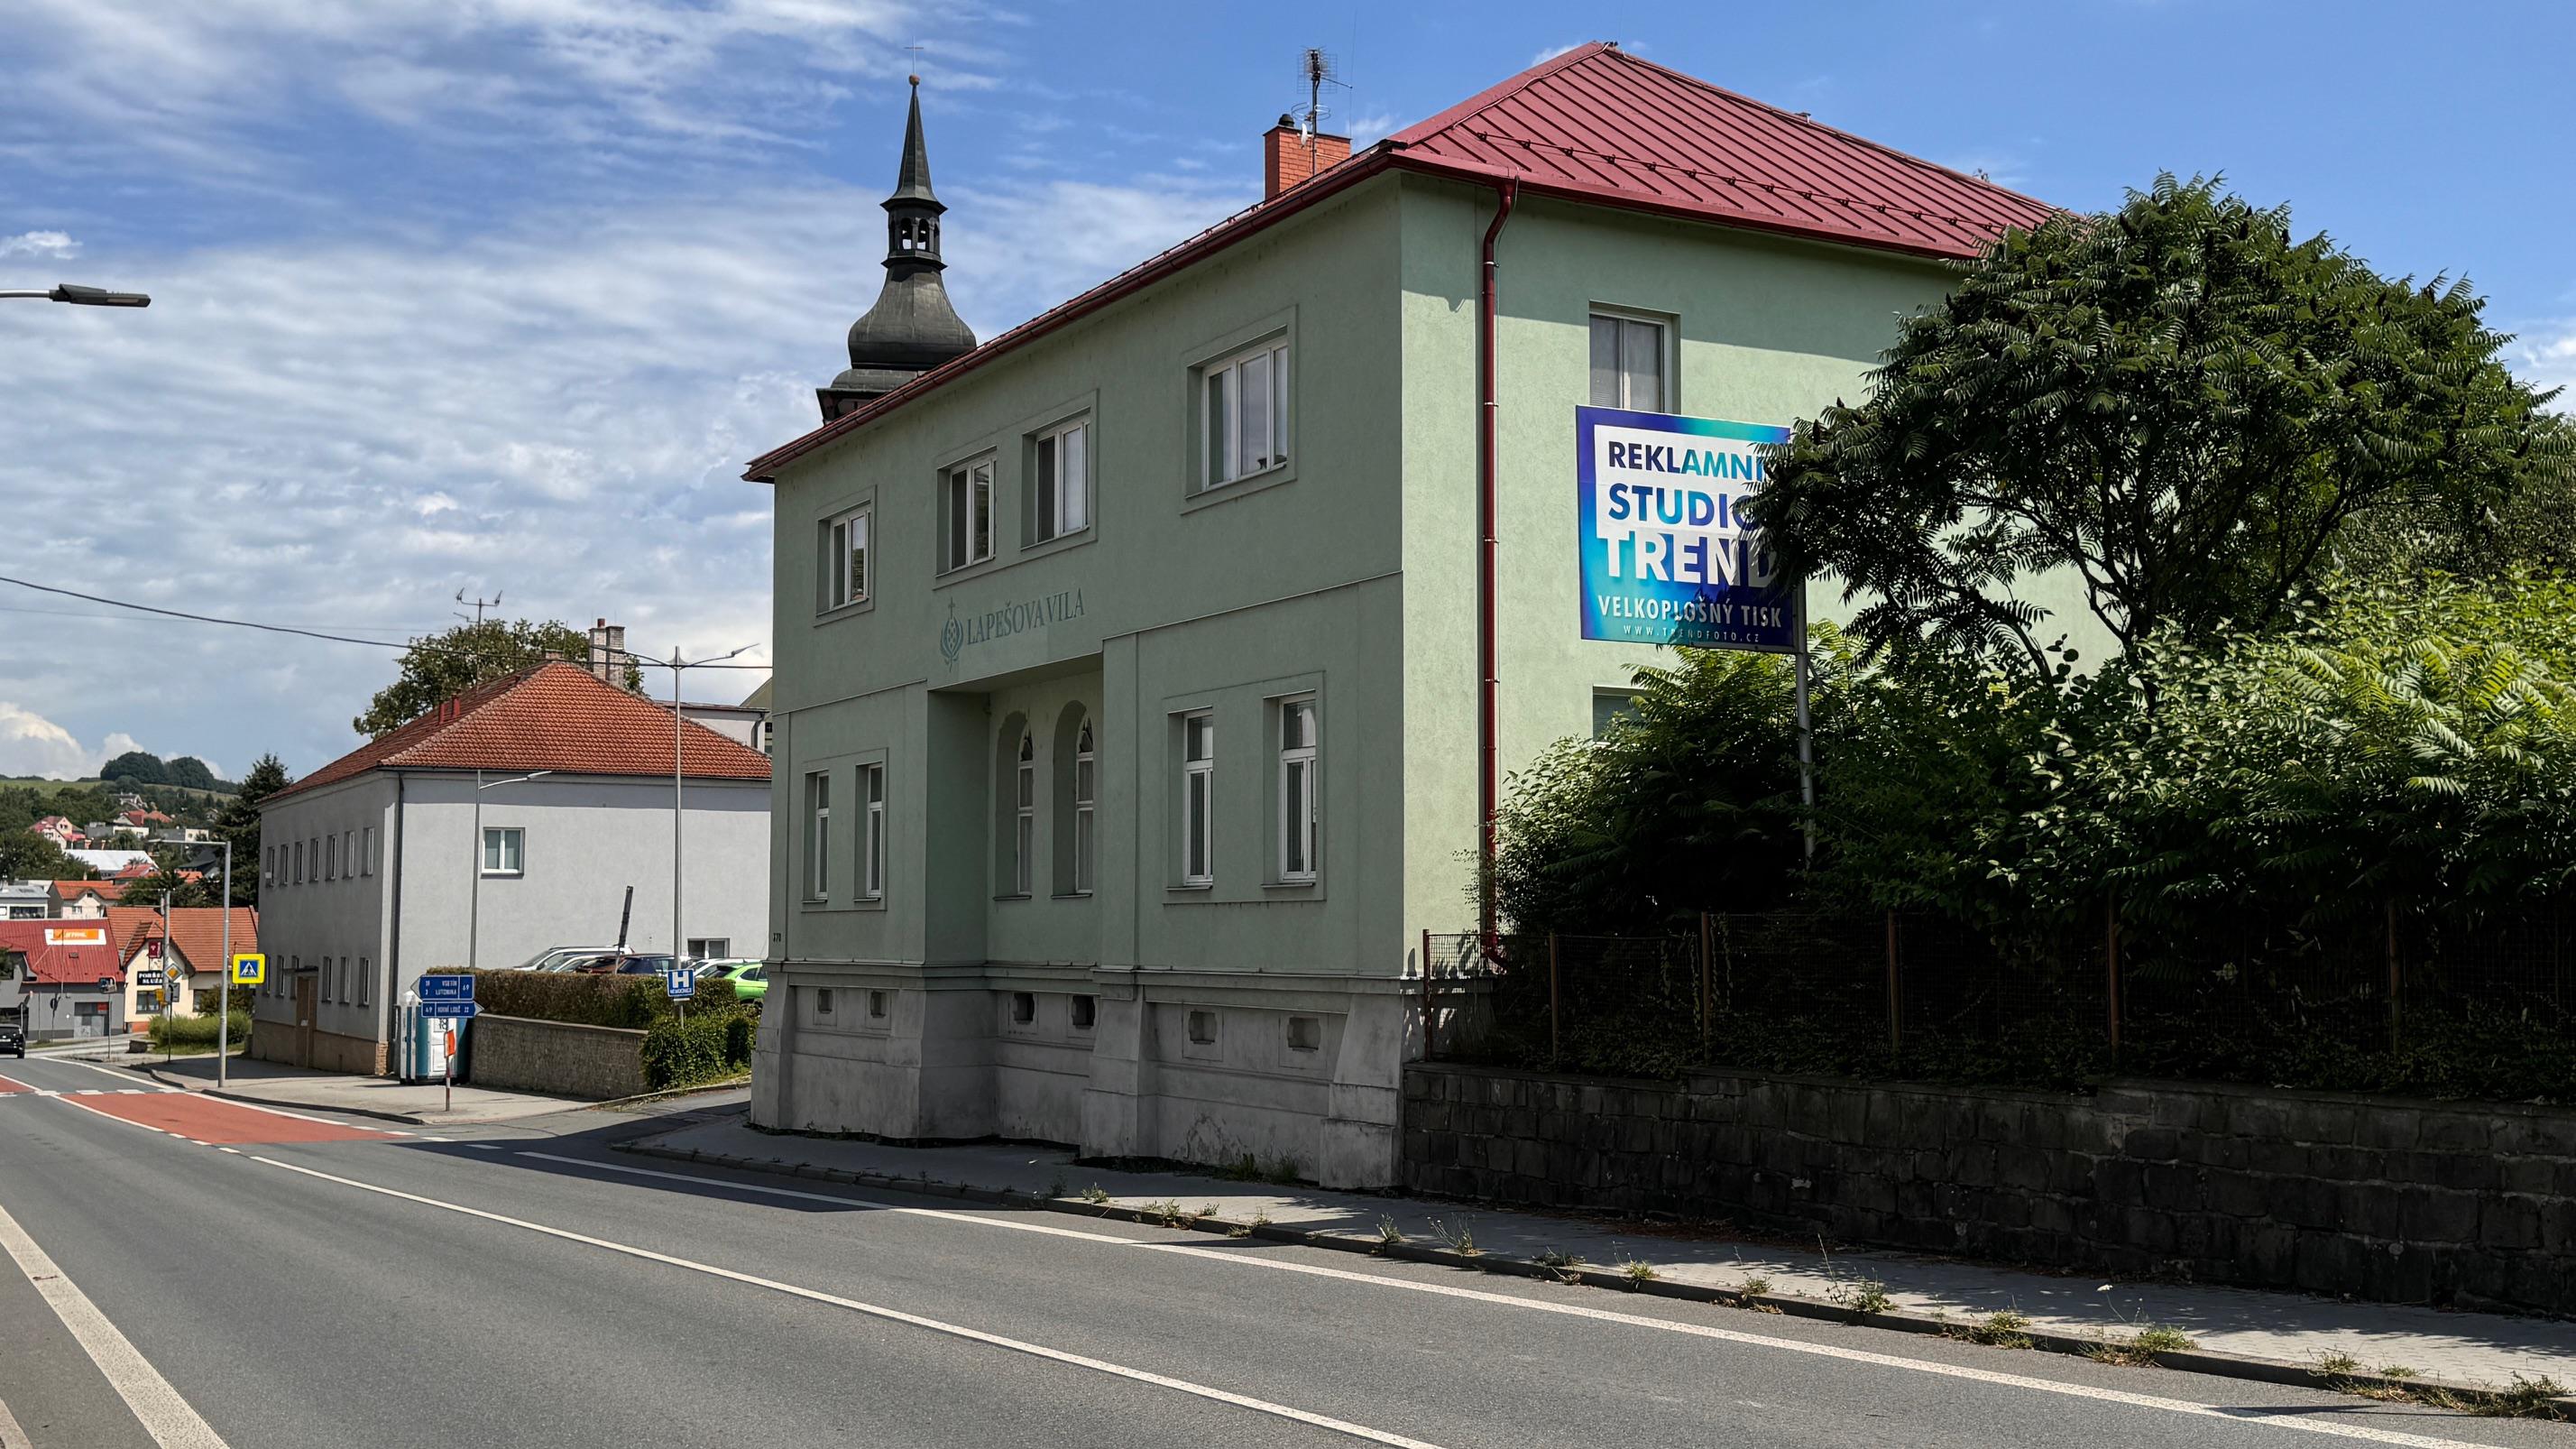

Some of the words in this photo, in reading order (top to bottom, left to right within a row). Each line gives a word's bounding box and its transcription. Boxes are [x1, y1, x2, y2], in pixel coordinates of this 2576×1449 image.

[1597, 530, 1780, 588] TREND
[967, 599, 1044, 645] LAPEŠOVA
[1046, 587, 1085, 623] VILA
[1597, 595, 1734, 625] VELKOPLOŠNÝ
[1741, 605, 1781, 628] TISK
[672, 971, 689, 988] H
